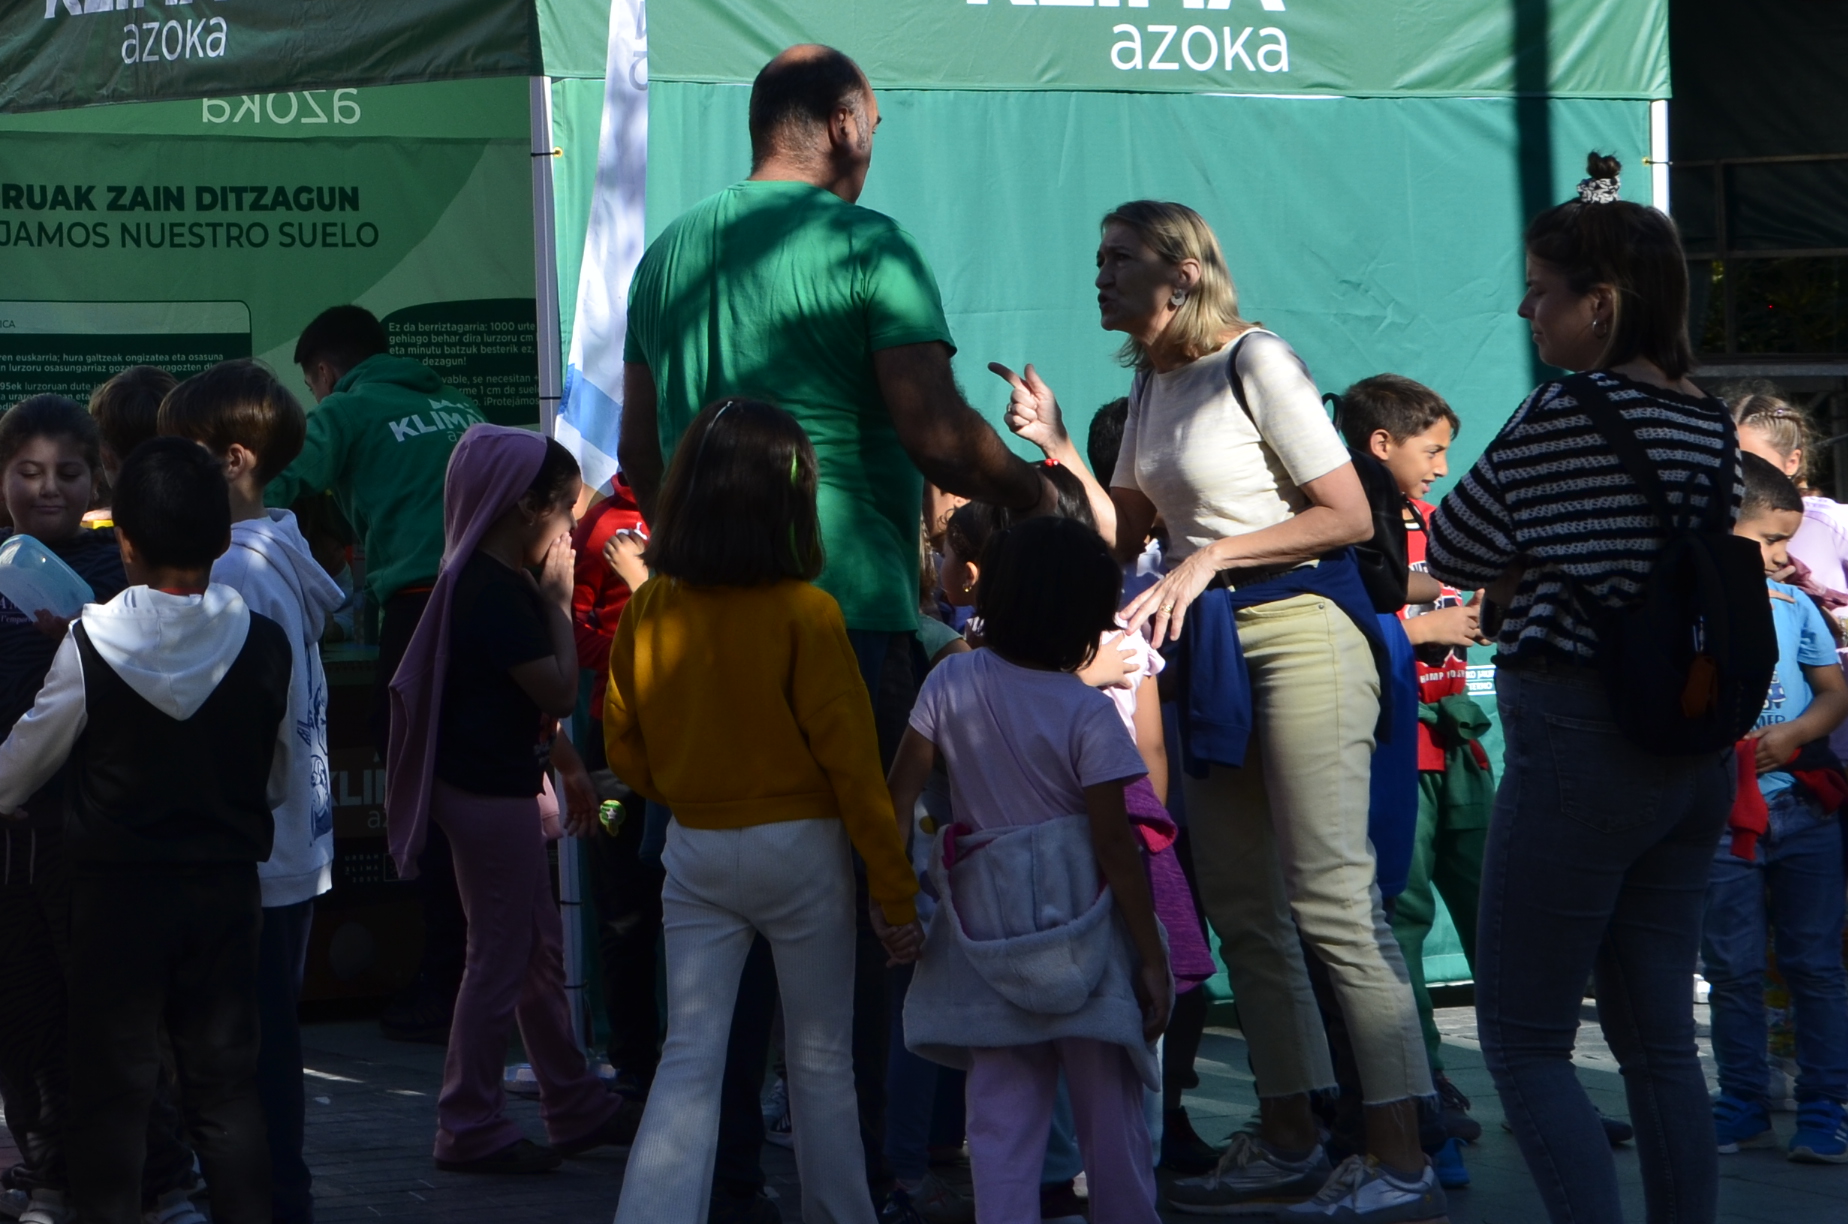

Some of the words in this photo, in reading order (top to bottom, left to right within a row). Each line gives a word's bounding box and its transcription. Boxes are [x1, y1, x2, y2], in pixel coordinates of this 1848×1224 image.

[121, 16, 228, 64] azoka
[1110, 23, 1289, 73] azoka
[106, 185, 185, 212] ZAIN
[195, 185, 360, 212] DITZAGUN
[120, 222, 268, 248] NUESTRO
[279, 222, 379, 248] SUELO
[389, 323, 401, 332] Ez
[403, 323, 416, 332] da
[418, 322, 488, 333] berriztagarria:
[490, 322, 515, 331] 1000
[389, 334, 429, 344] gehiago
[431, 334, 460, 343] behar
[462, 334, 482, 342] dira
[484, 333, 518, 342] lurzoru
[389, 346, 405, 355] eta
[407, 345, 442, 354] minutu
[444, 345, 478, 354] batzuk
[480, 344, 519, 353] besterik
[16, 353, 60, 363] euskarria;
[63, 353, 83, 362] hura
[86, 354, 123, 364] galtzeak
[125, 353, 169, 364] ongizatea
[172, 354, 186, 362] eta
[188, 353, 224, 362] osasuna
[422, 356, 467, 367] dezagun!
[9, 363, 42, 372] lurzoru
[44, 364, 107, 375] osasungarriaz
[441, 375, 470, 384] vable,
[486, 374, 530, 384] necesitan
[0, 382, 22, 391] 95ek
[25, 382, 68, 391] lurzoruan
[70, 382, 90, 391] dute
[504, 385, 516, 394] de
